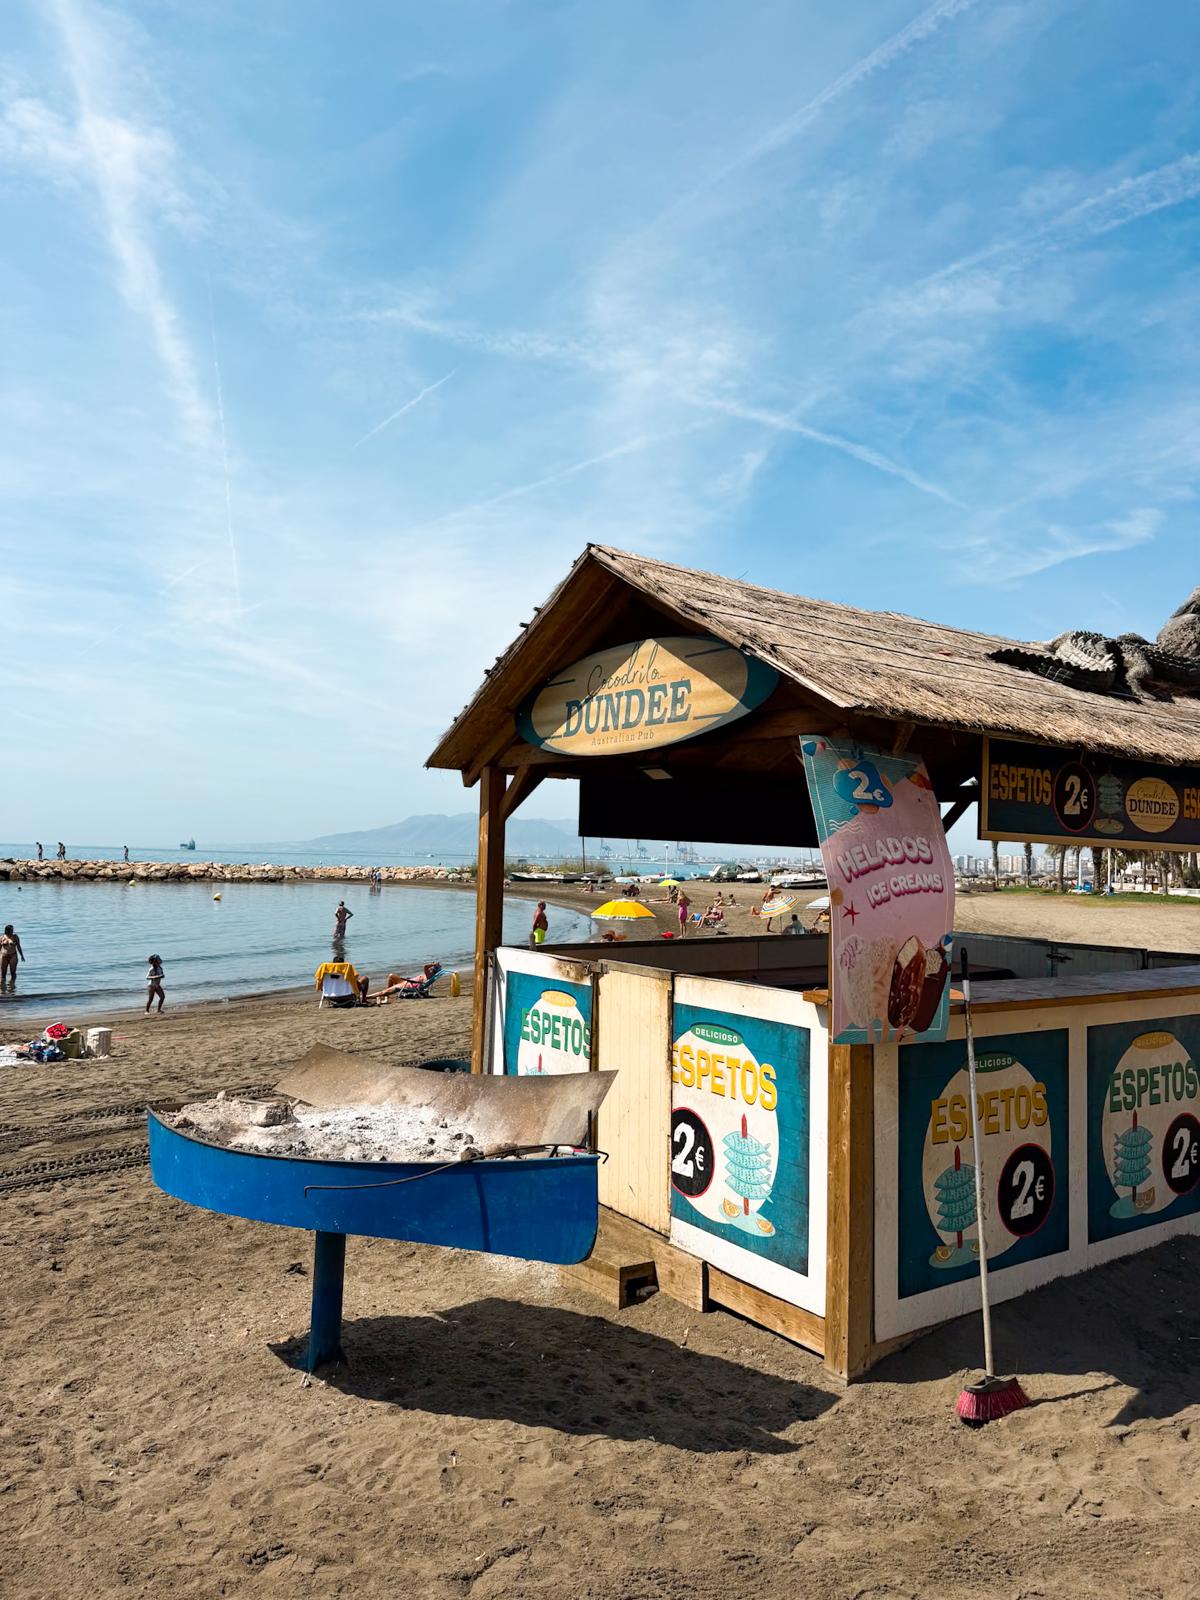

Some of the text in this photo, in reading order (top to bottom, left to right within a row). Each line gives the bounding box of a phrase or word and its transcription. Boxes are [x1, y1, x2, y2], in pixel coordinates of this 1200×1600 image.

[587, 641, 663, 698] Cocodrilo
[562, 680, 692, 738] DUNDEE
[591, 728, 655, 746] Australian Pub
[848, 770, 885, 802] 2€
[989, 763, 1051, 806] ESPETOS
[1064, 774, 1089, 815] 2€
[1129, 798, 1176, 816] DUNDEE
[837, 836, 933, 883] HELADOS
[866, 873, 944, 909] ICE CREAMS
[521, 1007, 591, 1060] ESPETOS
[695, 1027, 738, 1044] DELICIOSO
[974, 1056, 1012, 1069] ELICIOSO
[1109, 1059, 1198, 1114] ESPETOS
[931, 1081, 1048, 1145] ESPETOS
[672, 1121, 705, 1179] 2€
[1171, 1127, 1198, 1179] 2€
[1010, 1160, 1045, 1220] 2€
